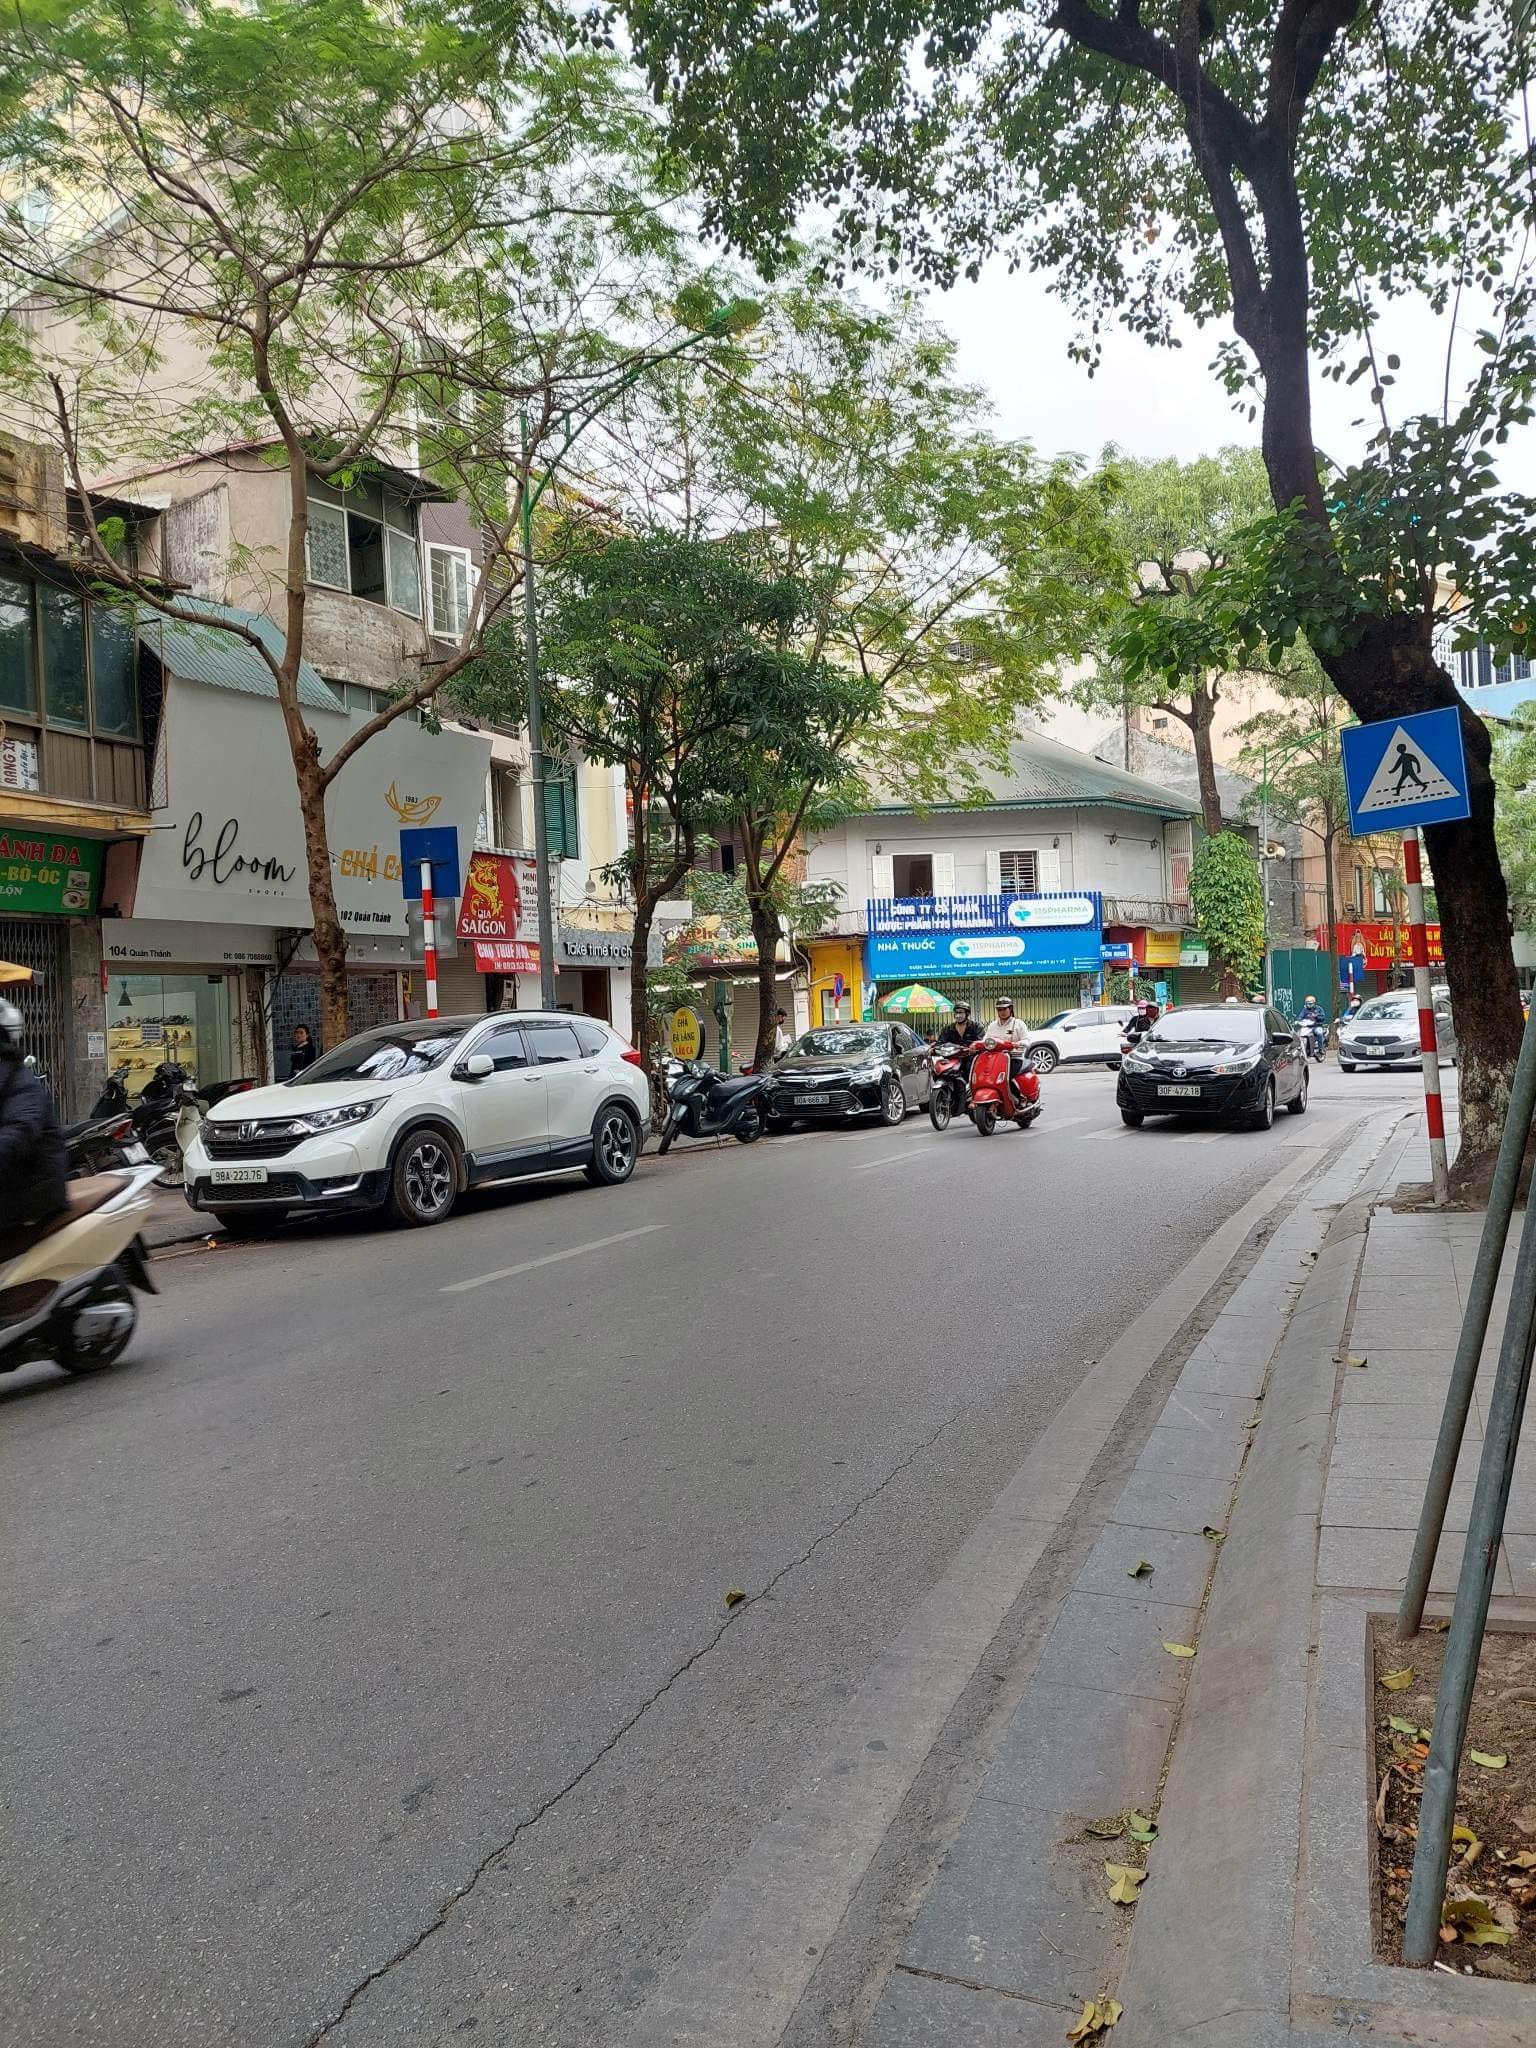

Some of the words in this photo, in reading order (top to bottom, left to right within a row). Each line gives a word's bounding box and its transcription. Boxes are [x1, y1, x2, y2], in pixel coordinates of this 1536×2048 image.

[3, 753, 17, 785] RANG
[183, 811, 296, 884] bloom
[340, 911, 352, 920] 102
[919, 904, 931, 914] TY
[462, 918, 506, 935] SAIGON
[952, 918, 994, 929] PHARMA
[109, 945, 127, 957] 104
[566, 942, 587, 956] Take
[589, 943, 608, 957] time
[610, 944, 619, 958] to
[877, 940, 899, 951] NHÀ
[900, 938, 936, 951] THUỐC
[215, 1169, 262, 1182] 98A-223.76
